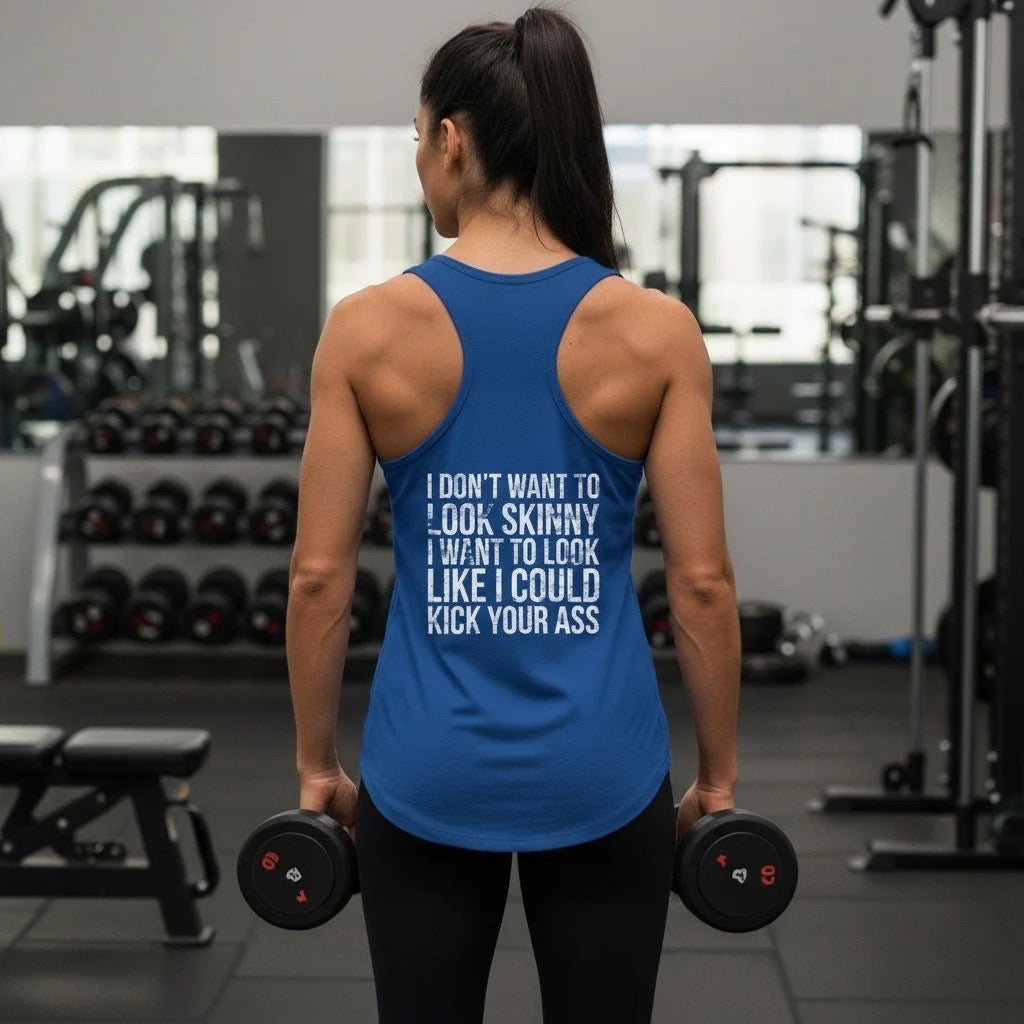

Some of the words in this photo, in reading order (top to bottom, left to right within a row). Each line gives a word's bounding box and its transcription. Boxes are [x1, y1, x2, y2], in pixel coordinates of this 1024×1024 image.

[427, 473, 432, 499] I
[439, 473, 501, 499] DON'T
[507, 474, 567, 499] WANT
[574, 474, 600, 499] TO
[428, 503, 494, 535] LOOK
[502, 503, 599, 535] SKINNY
[428, 539, 432, 565] I
[439, 538, 504, 565] WANT
[510, 538, 536, 565] TO
[544, 538, 600, 565] LOOK
[427, 568, 486, 602] LIKE
[496, 568, 502, 602] I
[511, 568, 600, 603] COULD
[428, 606, 480, 634] KICK
[487, 606, 548, 634] YOUR
[555, 606, 600, 634] ASS
